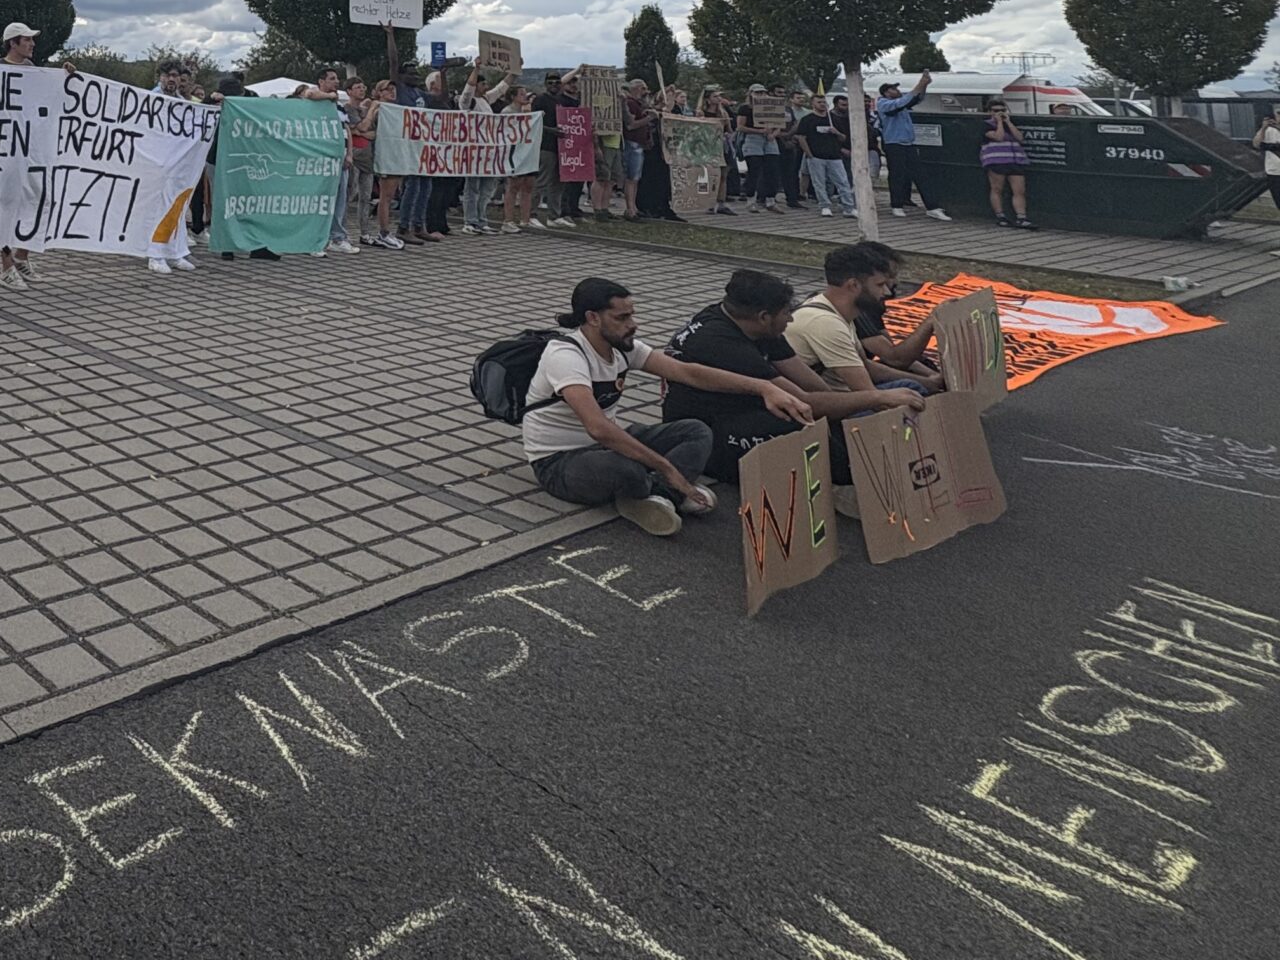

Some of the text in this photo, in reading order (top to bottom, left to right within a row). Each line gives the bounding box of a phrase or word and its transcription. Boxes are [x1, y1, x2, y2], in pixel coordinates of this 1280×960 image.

[385, 4, 411, 20] Hetze
[57, 116, 144, 166] ERFURT
[559, 151, 586, 173] illegal
[1105, 146, 1165, 161] 37940
[295, 156, 341, 177] GEGEN
[739, 441, 827, 584] WE
